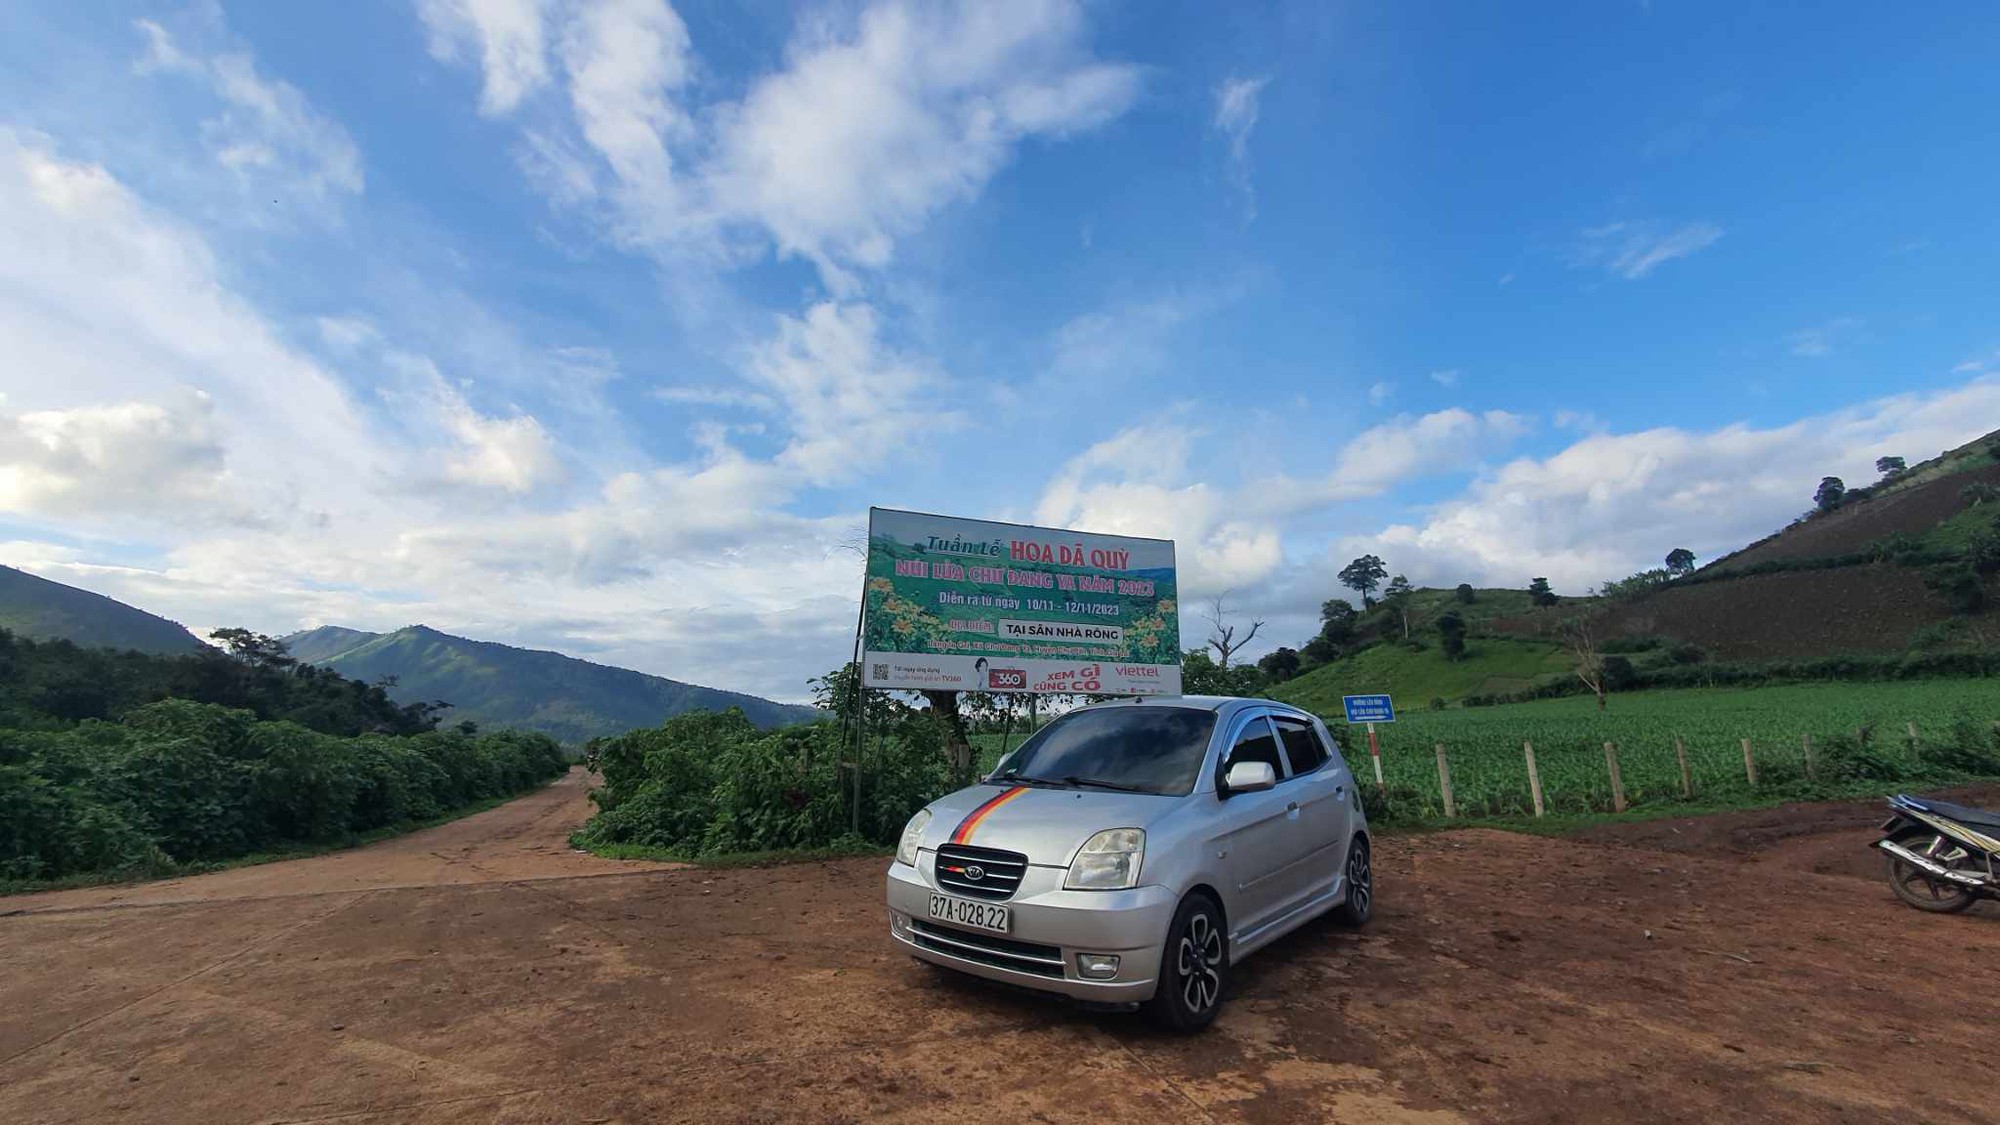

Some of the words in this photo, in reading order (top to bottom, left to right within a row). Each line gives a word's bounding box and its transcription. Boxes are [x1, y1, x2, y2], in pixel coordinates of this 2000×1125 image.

[1011, 540, 1054, 564] HOA
[1059, 543, 1085, 567] DÃ
[1007, 568, 1053, 588] ĐANG
[1056, 573, 1076, 591] YA
[1118, 579, 1155, 597] 2023
[967, 595, 979, 605] ra
[1027, 599, 1054, 611] 10/11
[1065, 601, 1119, 615] 12/11/2023
[1006, 624, 1025, 637] TẠI
[1028, 624, 1054, 636] SÂN
[1056, 626, 1083, 638] NHÀ
[998, 673, 1021, 685] 360
[1047, 670, 1074, 680] XEM
[1081, 664, 1100, 677] GÌ
[1115, 666, 1159, 677] viettel
[1072, 677, 1101, 691] CÓ
[931, 896, 1005, 930] 37A-028.22
